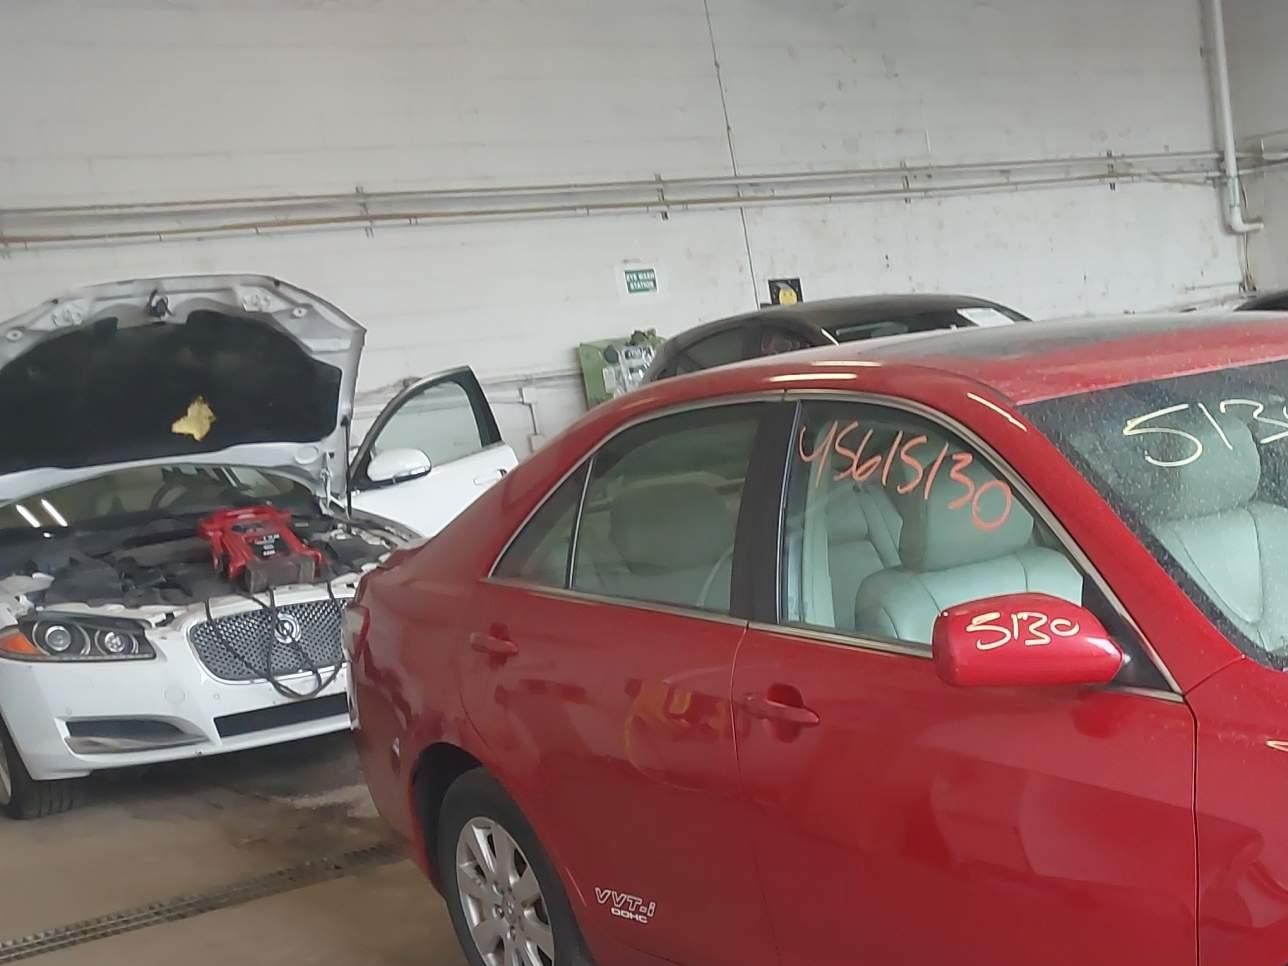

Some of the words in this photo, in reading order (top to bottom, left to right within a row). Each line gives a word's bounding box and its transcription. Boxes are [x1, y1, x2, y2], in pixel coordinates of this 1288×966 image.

[799, 419, 1012, 532] 45615130
[966, 611, 1080, 650] 5130
[611, 907, 649, 924] DOHC
